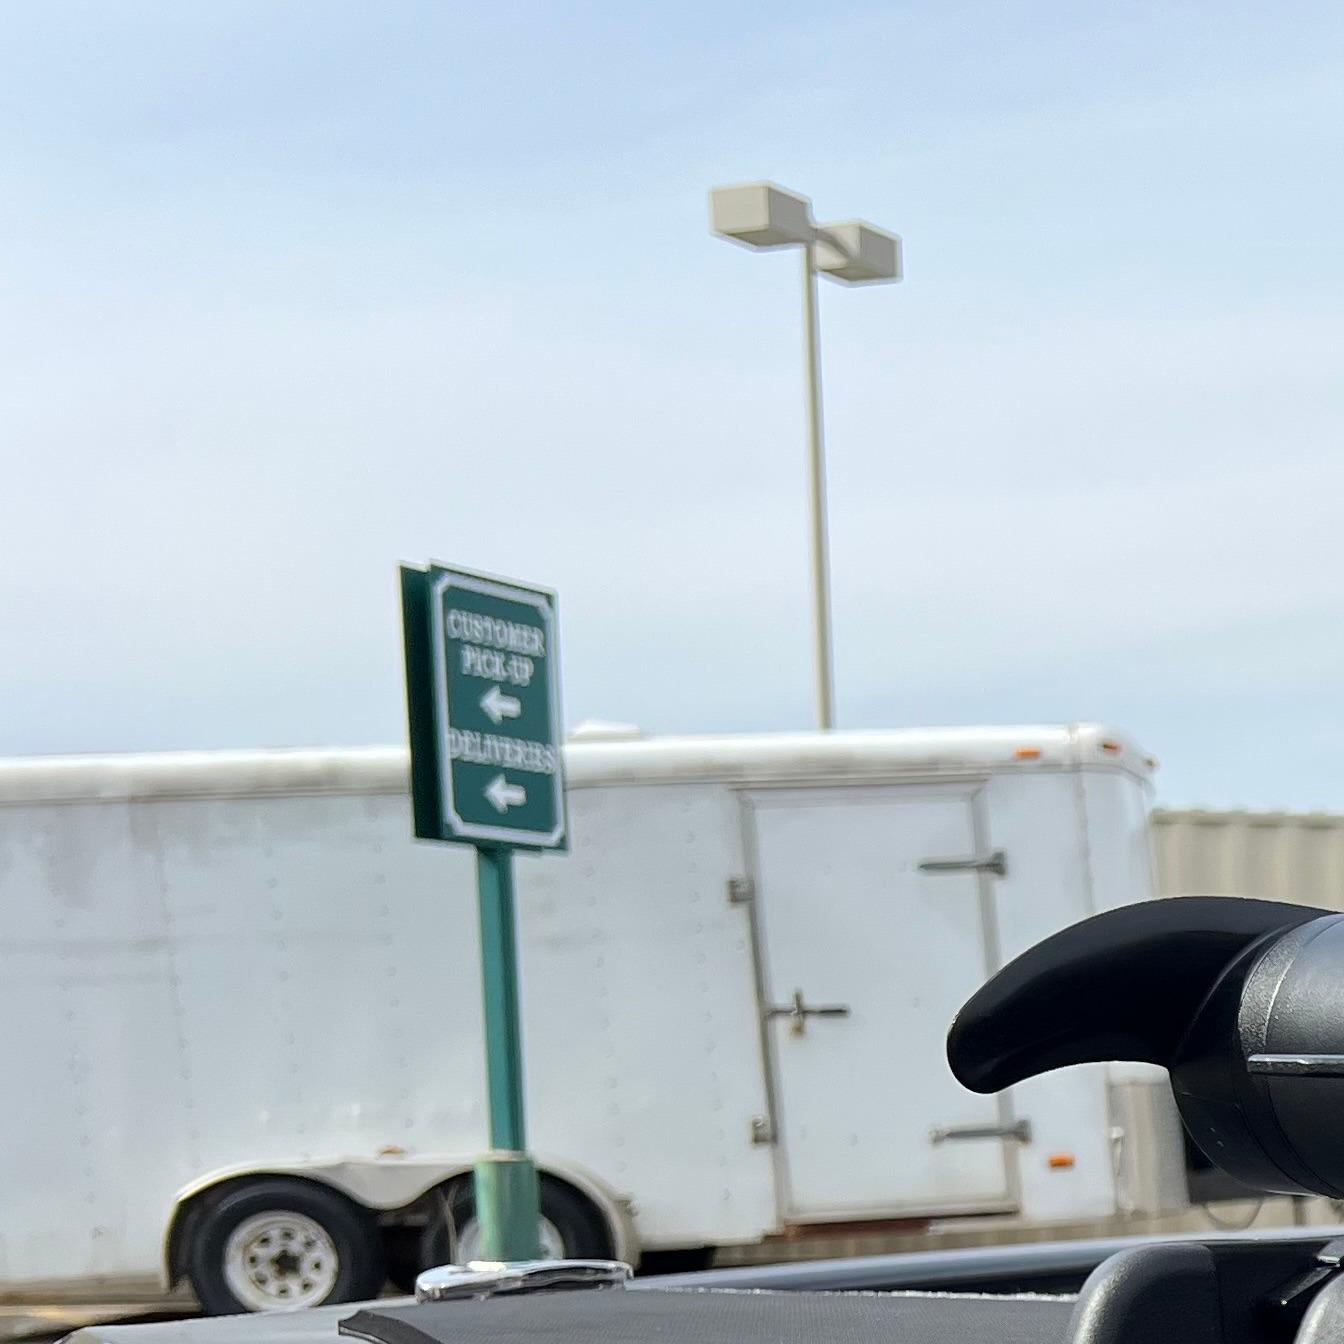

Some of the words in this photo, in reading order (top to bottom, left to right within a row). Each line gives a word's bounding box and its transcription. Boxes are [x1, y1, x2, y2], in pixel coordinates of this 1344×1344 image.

[446, 608, 544, 656] CUSTOMER
[461, 646, 534, 687] PICK-UP
[447, 727, 558, 775] DELIVERIES
